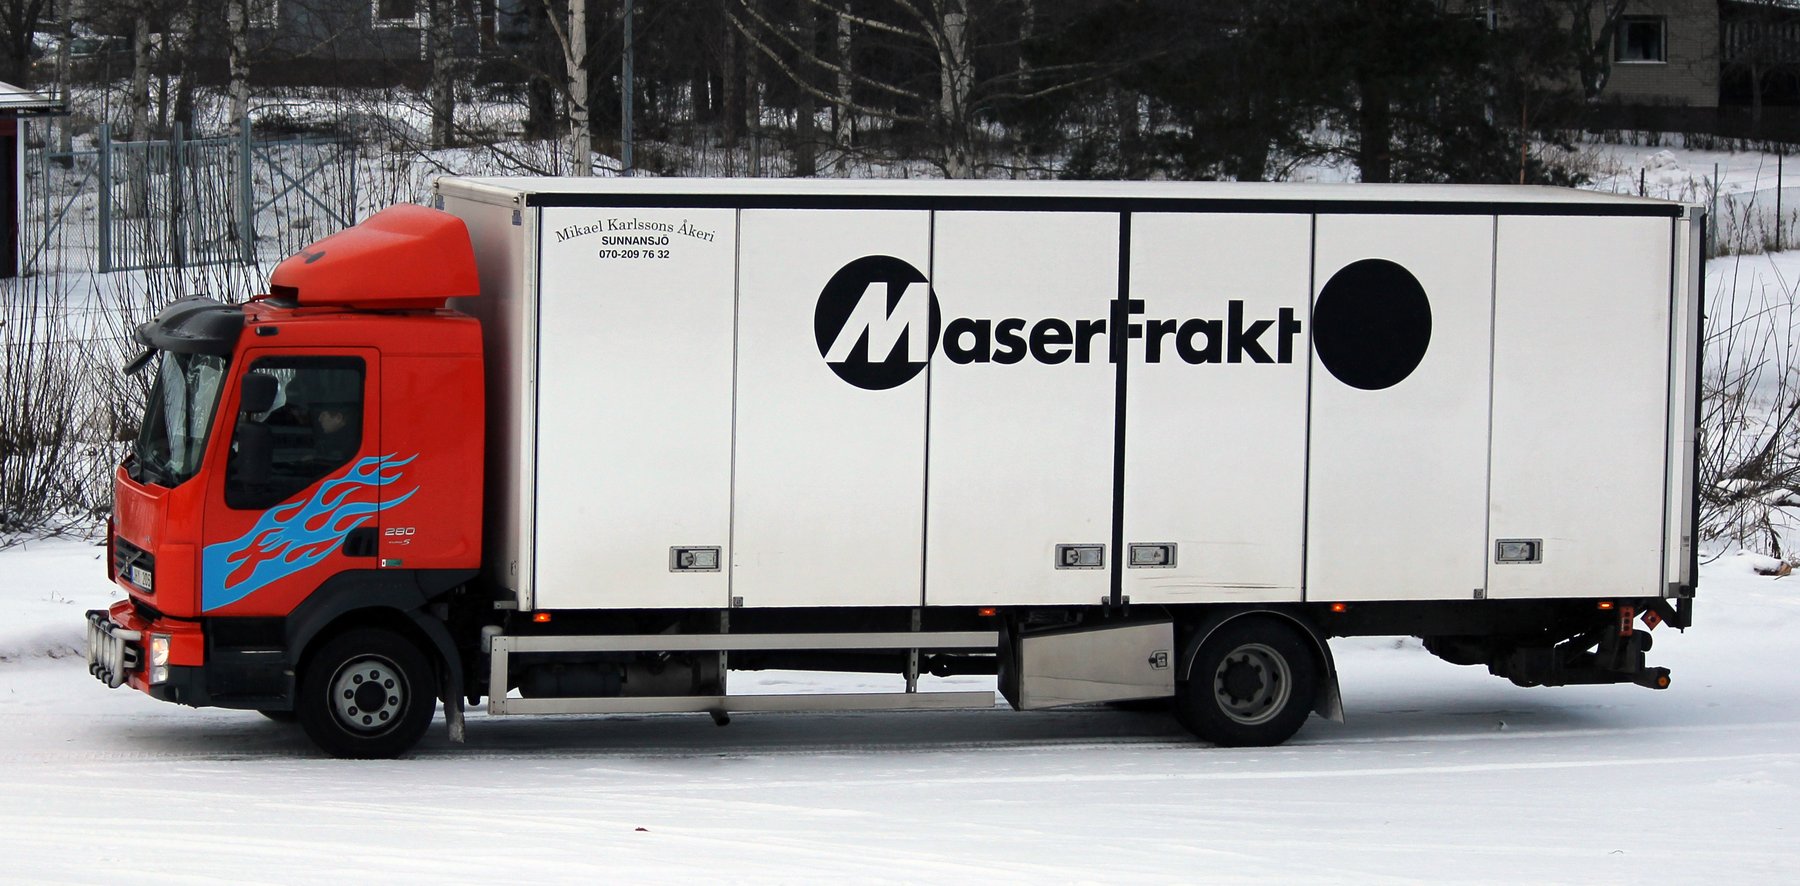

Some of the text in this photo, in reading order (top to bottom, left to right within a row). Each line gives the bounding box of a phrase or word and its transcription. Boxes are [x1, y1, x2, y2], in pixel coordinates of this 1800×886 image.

[555, 217, 716, 243] Mikael Karlssons Åkeri
[601, 234, 669, 246] SUNNANSJÖ
[599, 249, 670, 259] 070-209 76 32
[384, 527, 416, 536] 280
